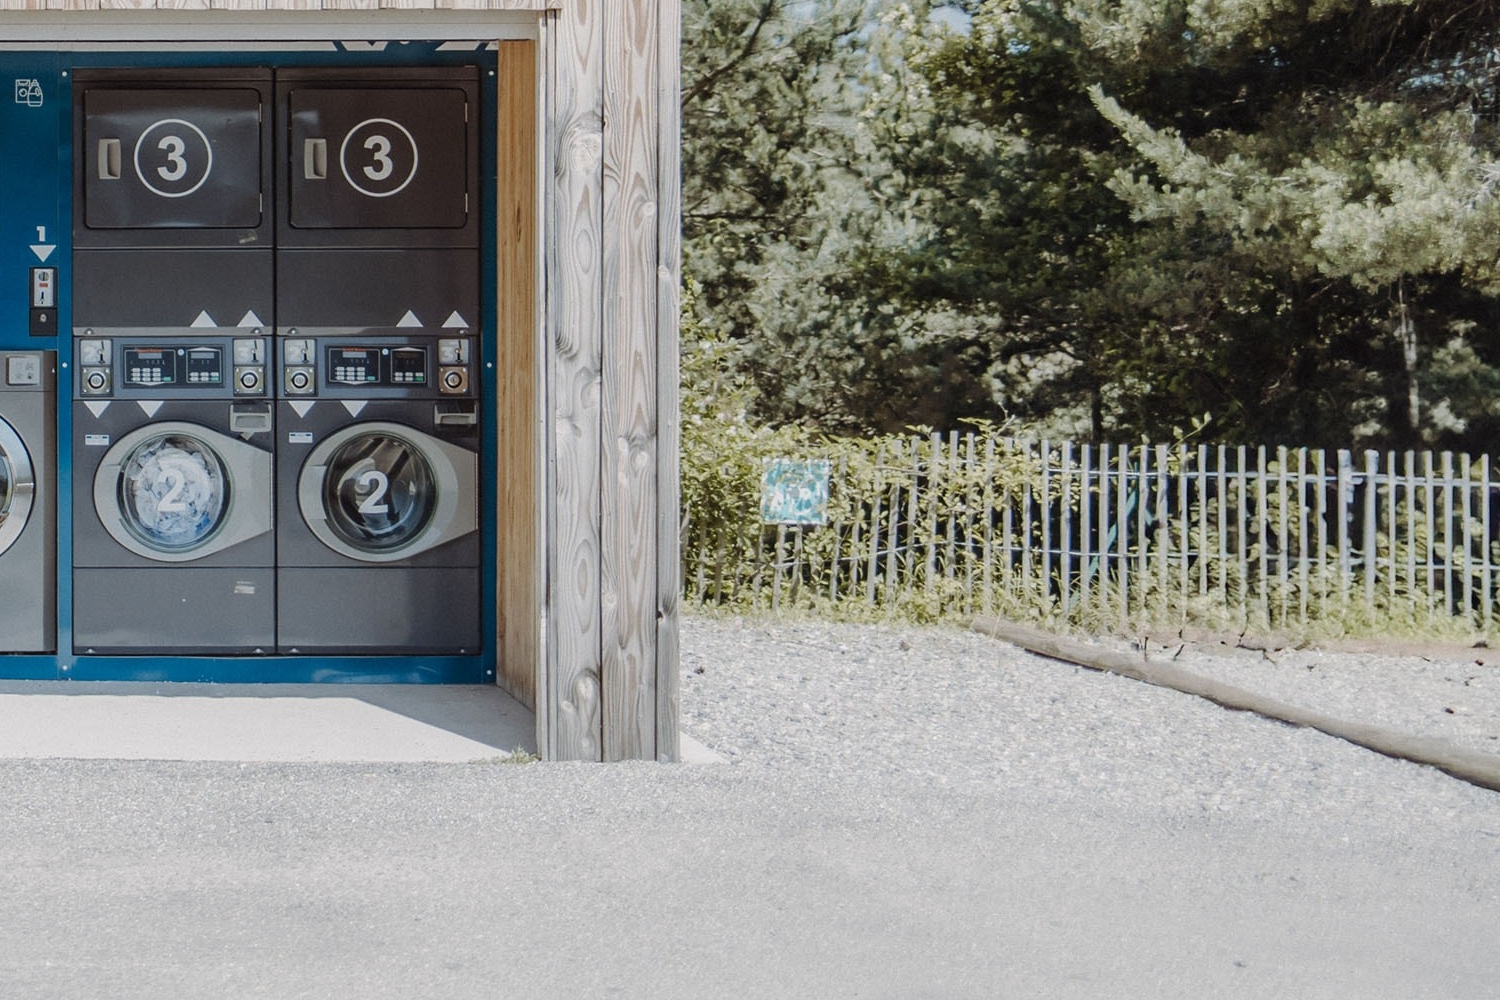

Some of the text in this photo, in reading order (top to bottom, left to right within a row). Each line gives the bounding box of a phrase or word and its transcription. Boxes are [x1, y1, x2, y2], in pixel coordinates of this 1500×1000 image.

[156, 135, 188, 181] 3
[362, 135, 393, 181] 3
[36, 226, 45, 242] 1
[156, 468, 186, 513] 2
[358, 470, 389, 514] 2
